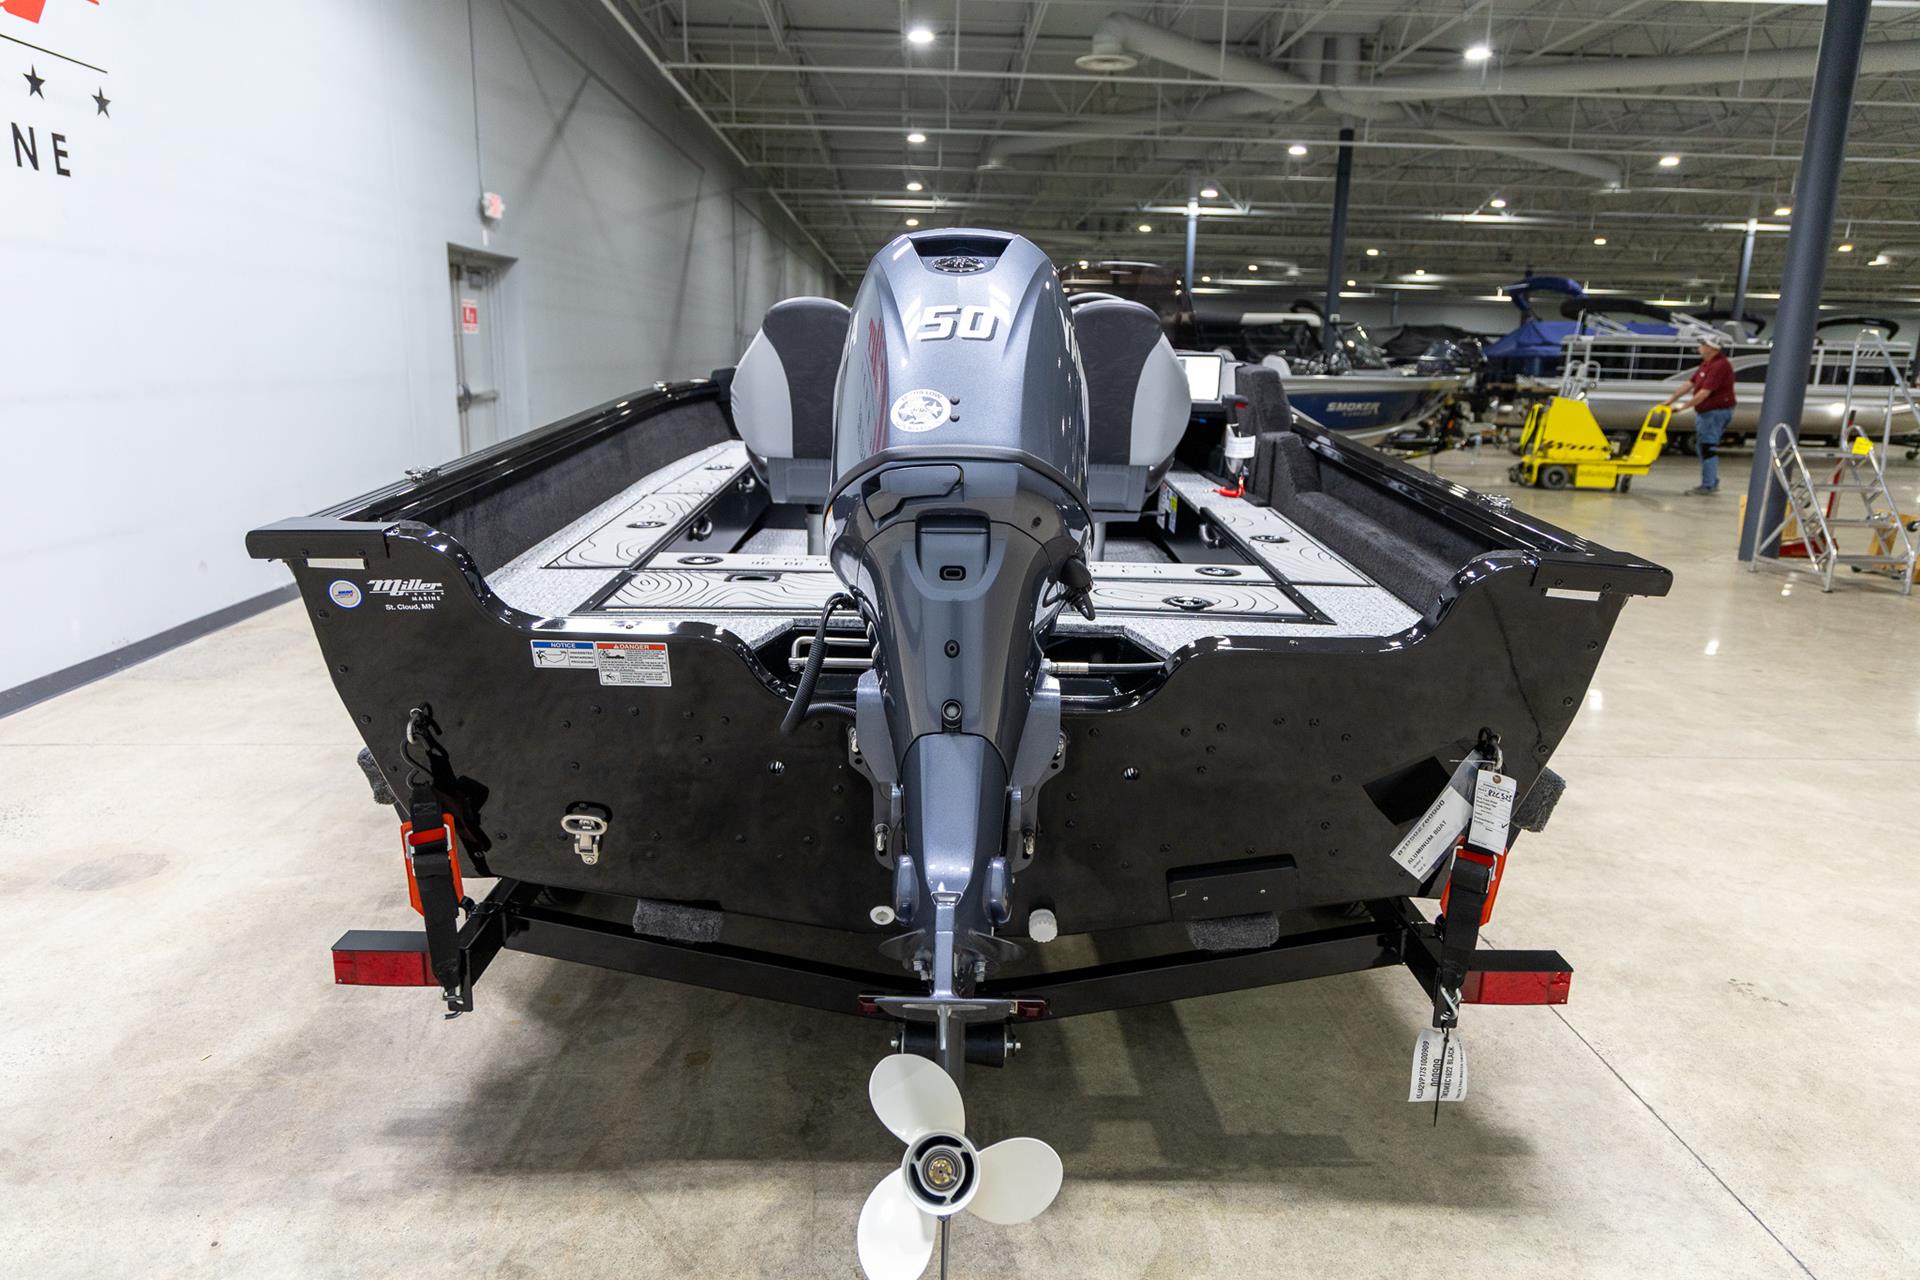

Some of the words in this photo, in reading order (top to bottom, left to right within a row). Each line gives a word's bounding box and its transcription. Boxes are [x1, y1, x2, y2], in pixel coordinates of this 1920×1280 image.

[11, 121, 71, 177] NE
[916, 305, 999, 342] 50
[367, 579, 443, 596] Miller
[397, 603, 421, 611] Cloud,
[1407, 835, 1434, 864] ALUMINUM
[1432, 820, 1447, 836] BOAT
[1446, 1046, 1455, 1065] BLACK
